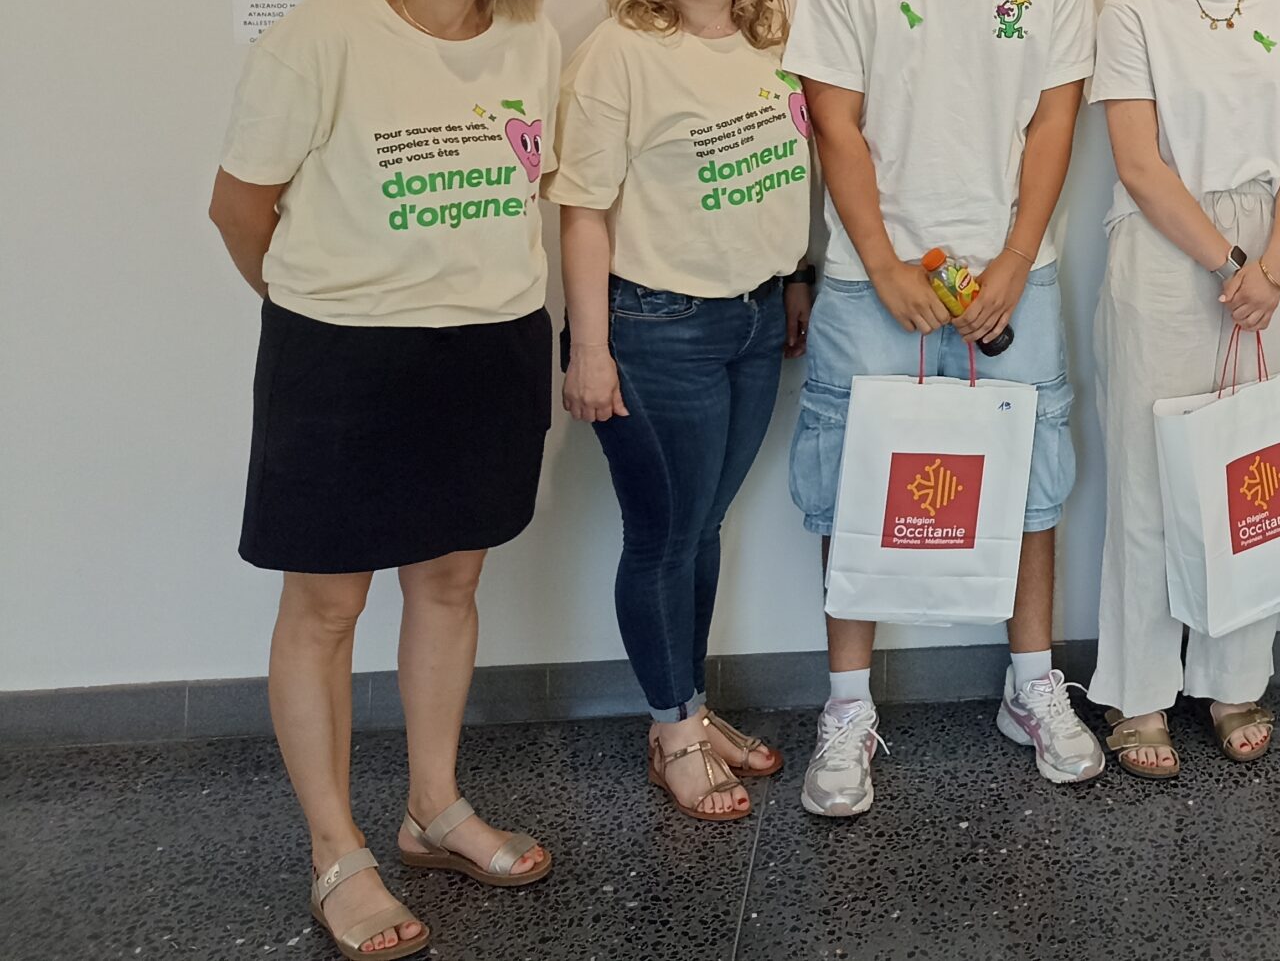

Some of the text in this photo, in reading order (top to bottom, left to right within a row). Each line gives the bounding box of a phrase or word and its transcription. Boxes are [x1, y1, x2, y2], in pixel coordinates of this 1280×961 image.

[374, 130, 402, 141] Pour
[405, 126, 442, 136] sauver
[445, 123, 463, 132] des
[690, 126, 713, 137] Pour
[716, 116, 744, 129] sauver
[745, 111, 758, 120] des
[694, 131, 736, 147] rappelez
[743, 124, 756, 132] vos
[757, 112, 787, 129] proches
[376, 133, 503, 154] rappelez à vos proches
[696, 141, 740, 158] que vous
[379, 148, 460, 168] que vous êtes
[698, 138, 797, 183] donneur
[382, 166, 516, 199] donneur
[895, 516, 935, 526] La Région
[1246, 511, 1269, 525] Région
[894, 524, 966, 538] Occitanie
